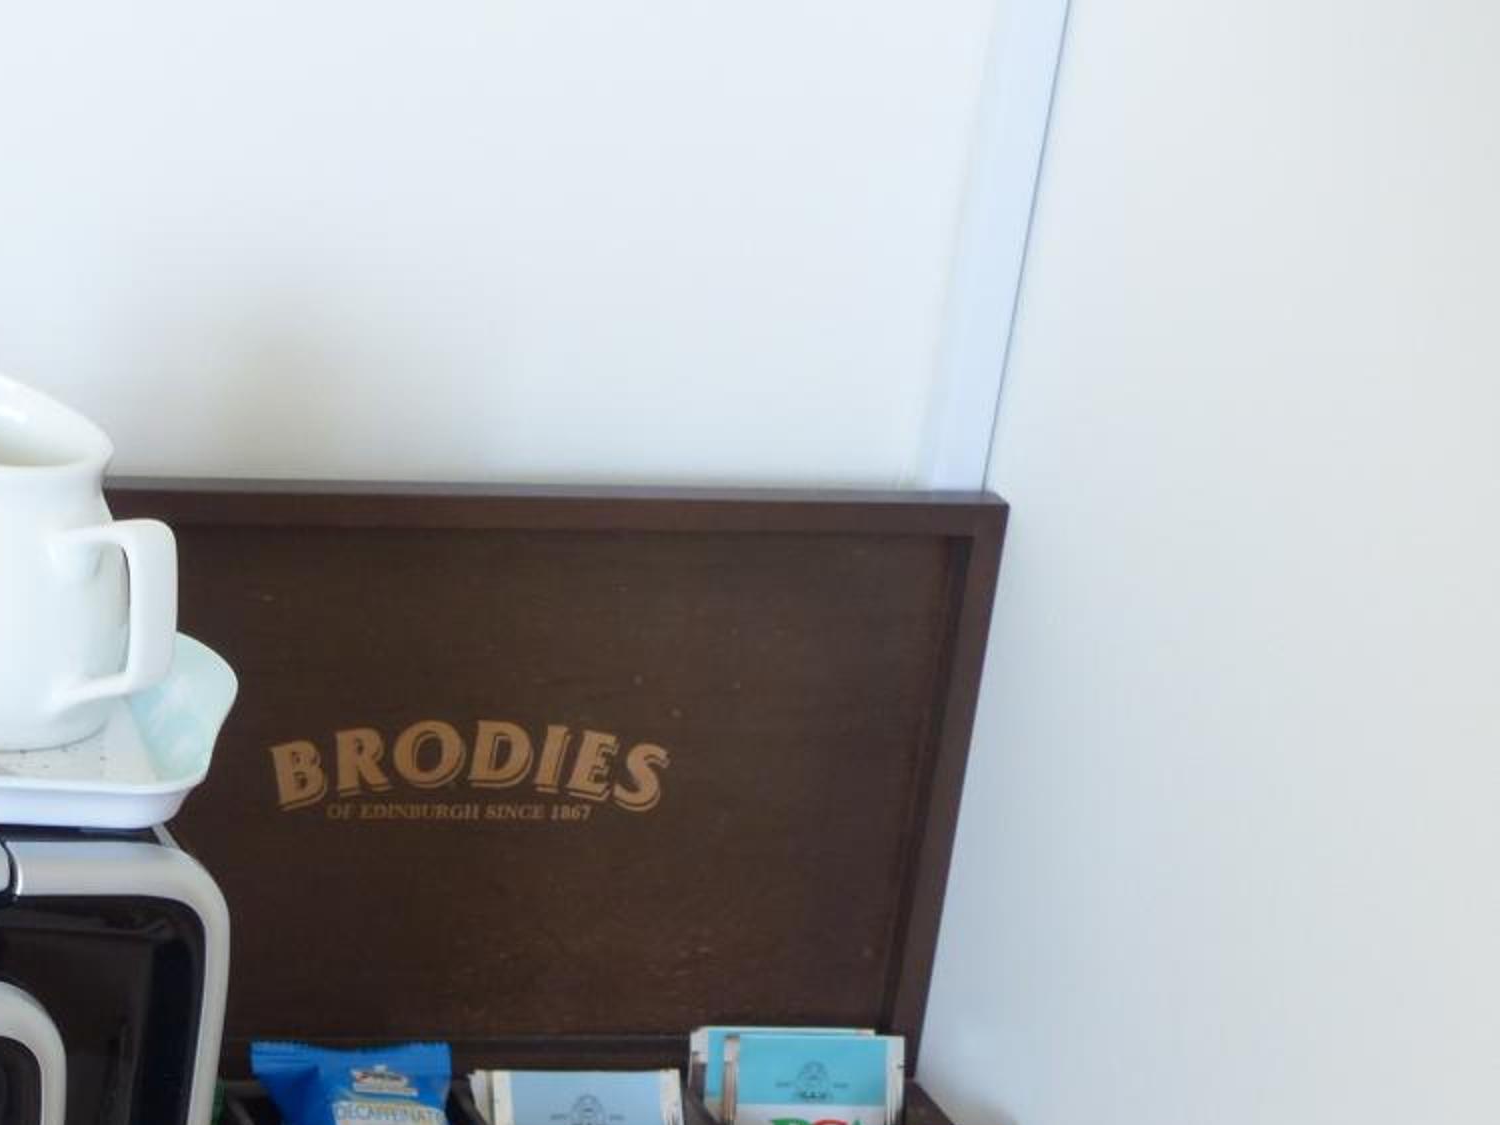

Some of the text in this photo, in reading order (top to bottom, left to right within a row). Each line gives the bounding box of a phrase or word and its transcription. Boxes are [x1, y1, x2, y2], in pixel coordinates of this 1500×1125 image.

[269, 719, 670, 813] BRODIES
[326, 804, 591, 821] OF EDINBURGH SINCE 1867
